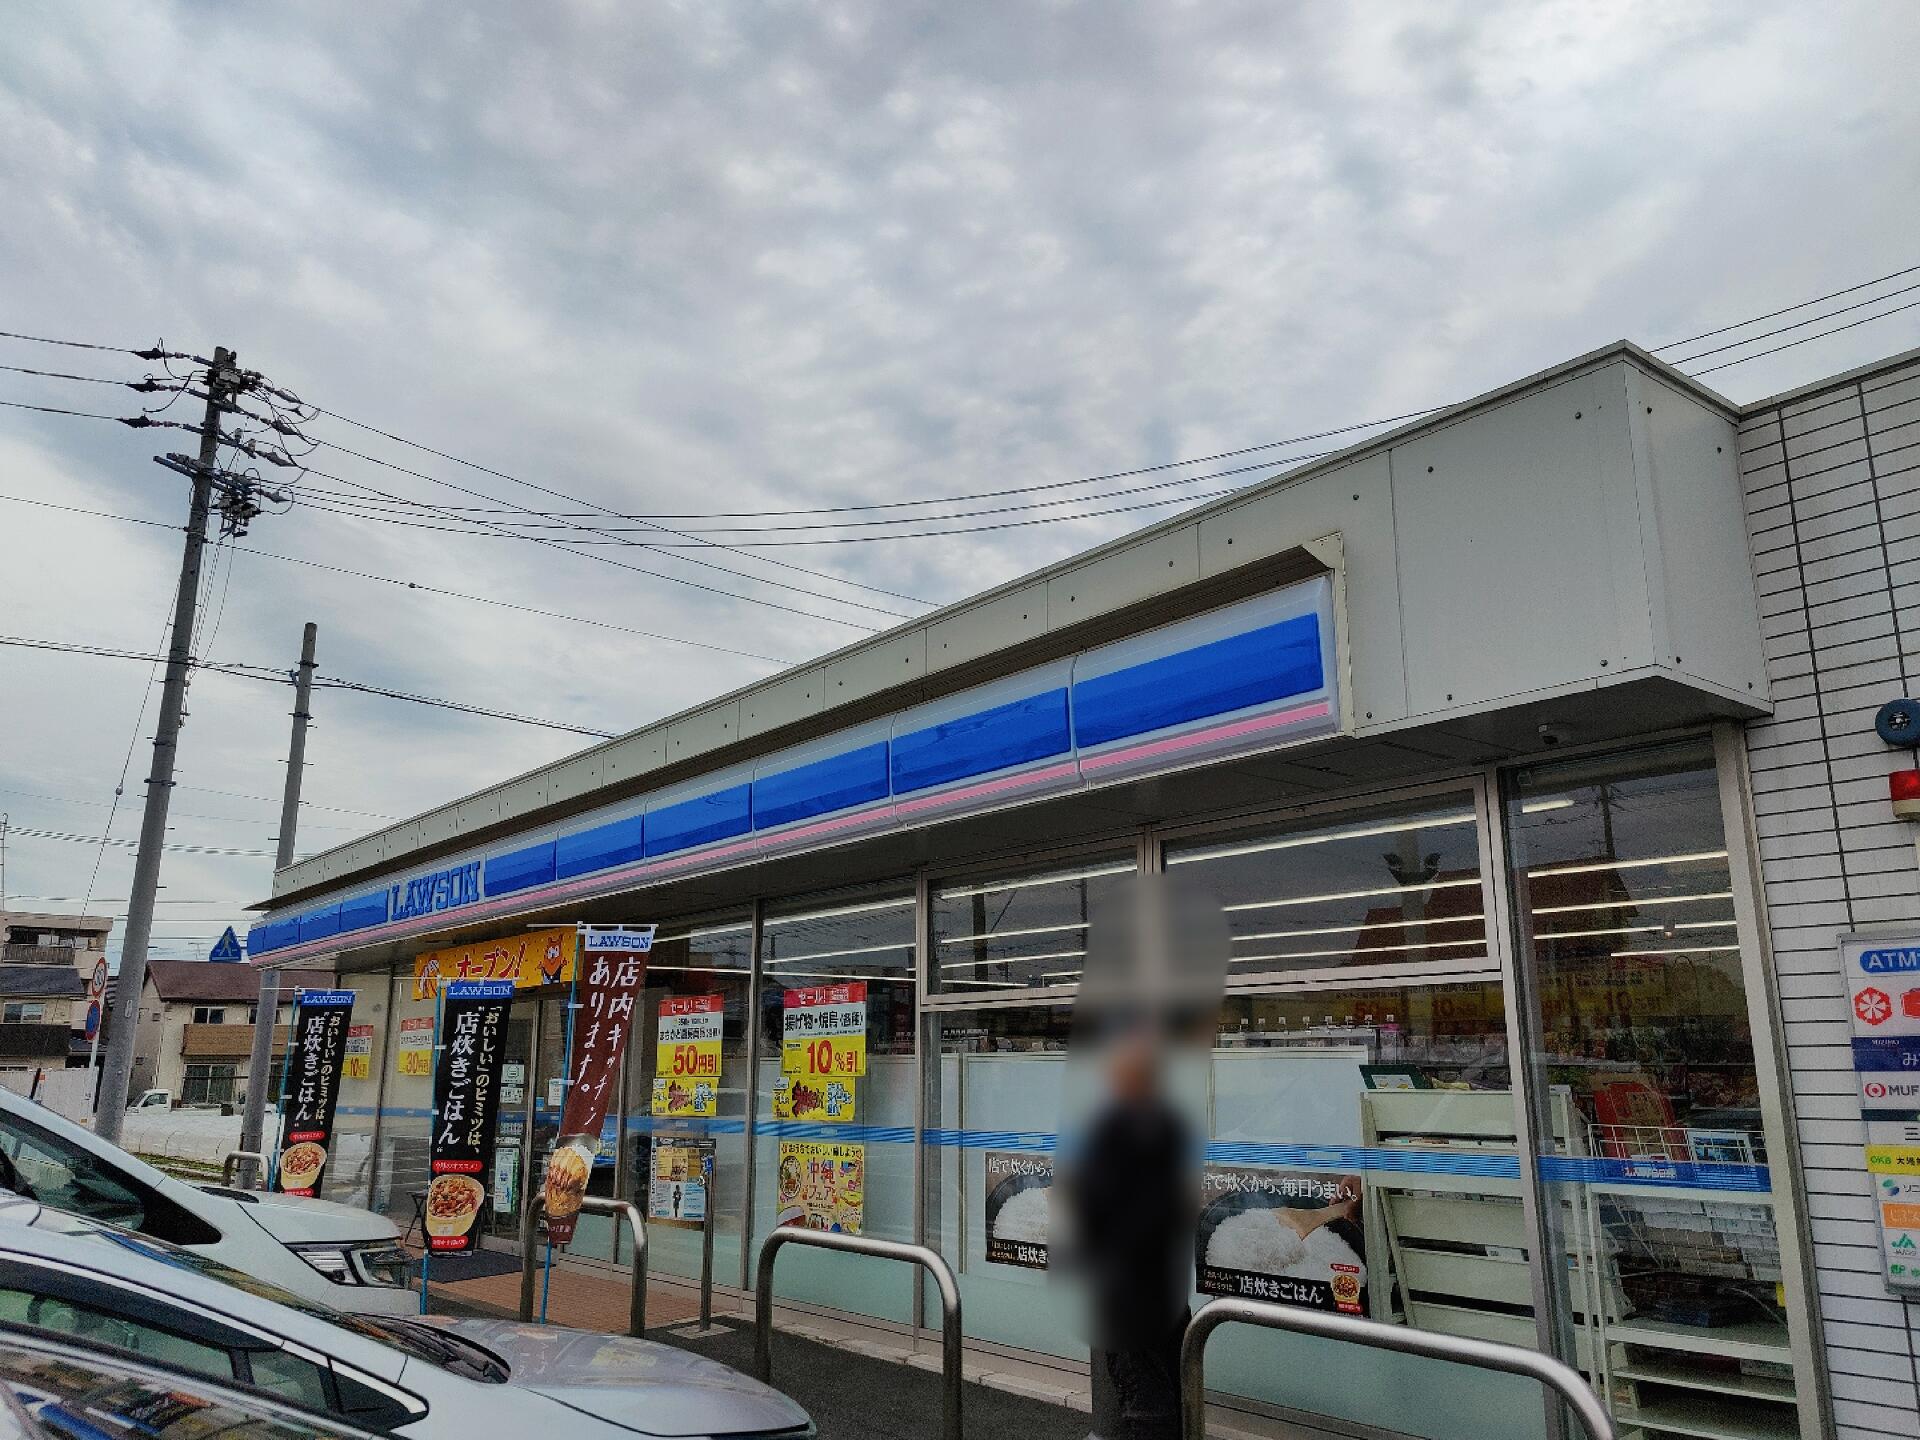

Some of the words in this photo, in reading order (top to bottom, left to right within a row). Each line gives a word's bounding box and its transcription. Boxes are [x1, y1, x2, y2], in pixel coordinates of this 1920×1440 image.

[391, 860, 481, 921] LAWSON
[588, 935, 651, 949] LAWSON
[455, 941, 527, 981] オープン!
[1867, 951, 1920, 969] ATM
[302, 995, 353, 1005] LAWSON
[448, 985, 512, 997] LAWSON
[576, 955, 611, 1093] あります。
[584, 955, 641, 1126] 店内キッチン
[672, 1044, 718, 1076] 50円引
[1902, 1052, 1920, 1067] み
